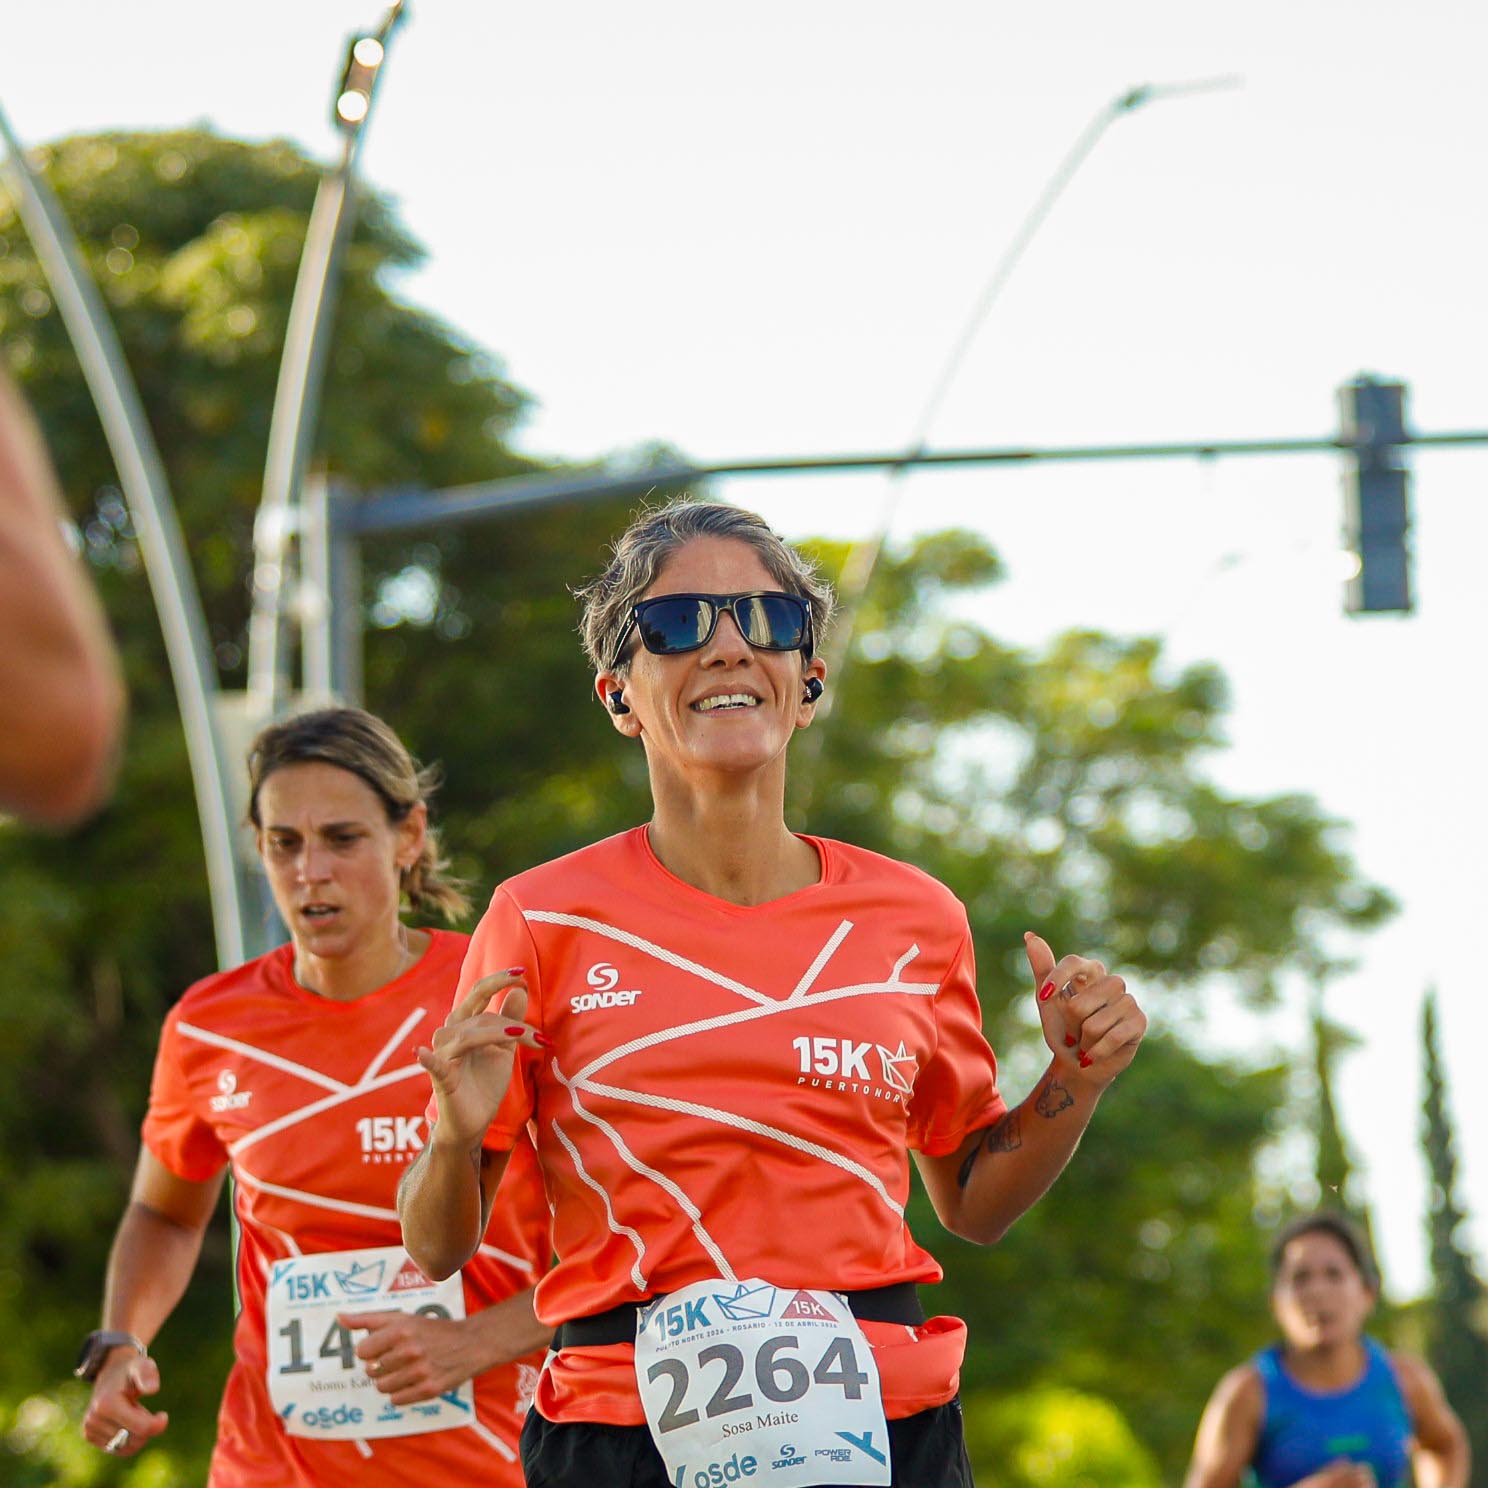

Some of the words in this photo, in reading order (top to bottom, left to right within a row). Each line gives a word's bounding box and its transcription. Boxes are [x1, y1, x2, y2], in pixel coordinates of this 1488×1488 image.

[792, 1036, 873, 1081] 15K
[355, 1115, 425, 1152] 15K
[286, 1271, 332, 1301] 15K
[654, 1296, 711, 1342] 15K
[792, 1299, 825, 1318] 15K
[732, 1322, 766, 1331] ROSARIO
[647, 1336, 869, 1435] 2264
[721, 1422, 754, 1439] Sosa
[756, 1411, 800, 1430] Maite
[814, 1448, 852, 1457] POWER
